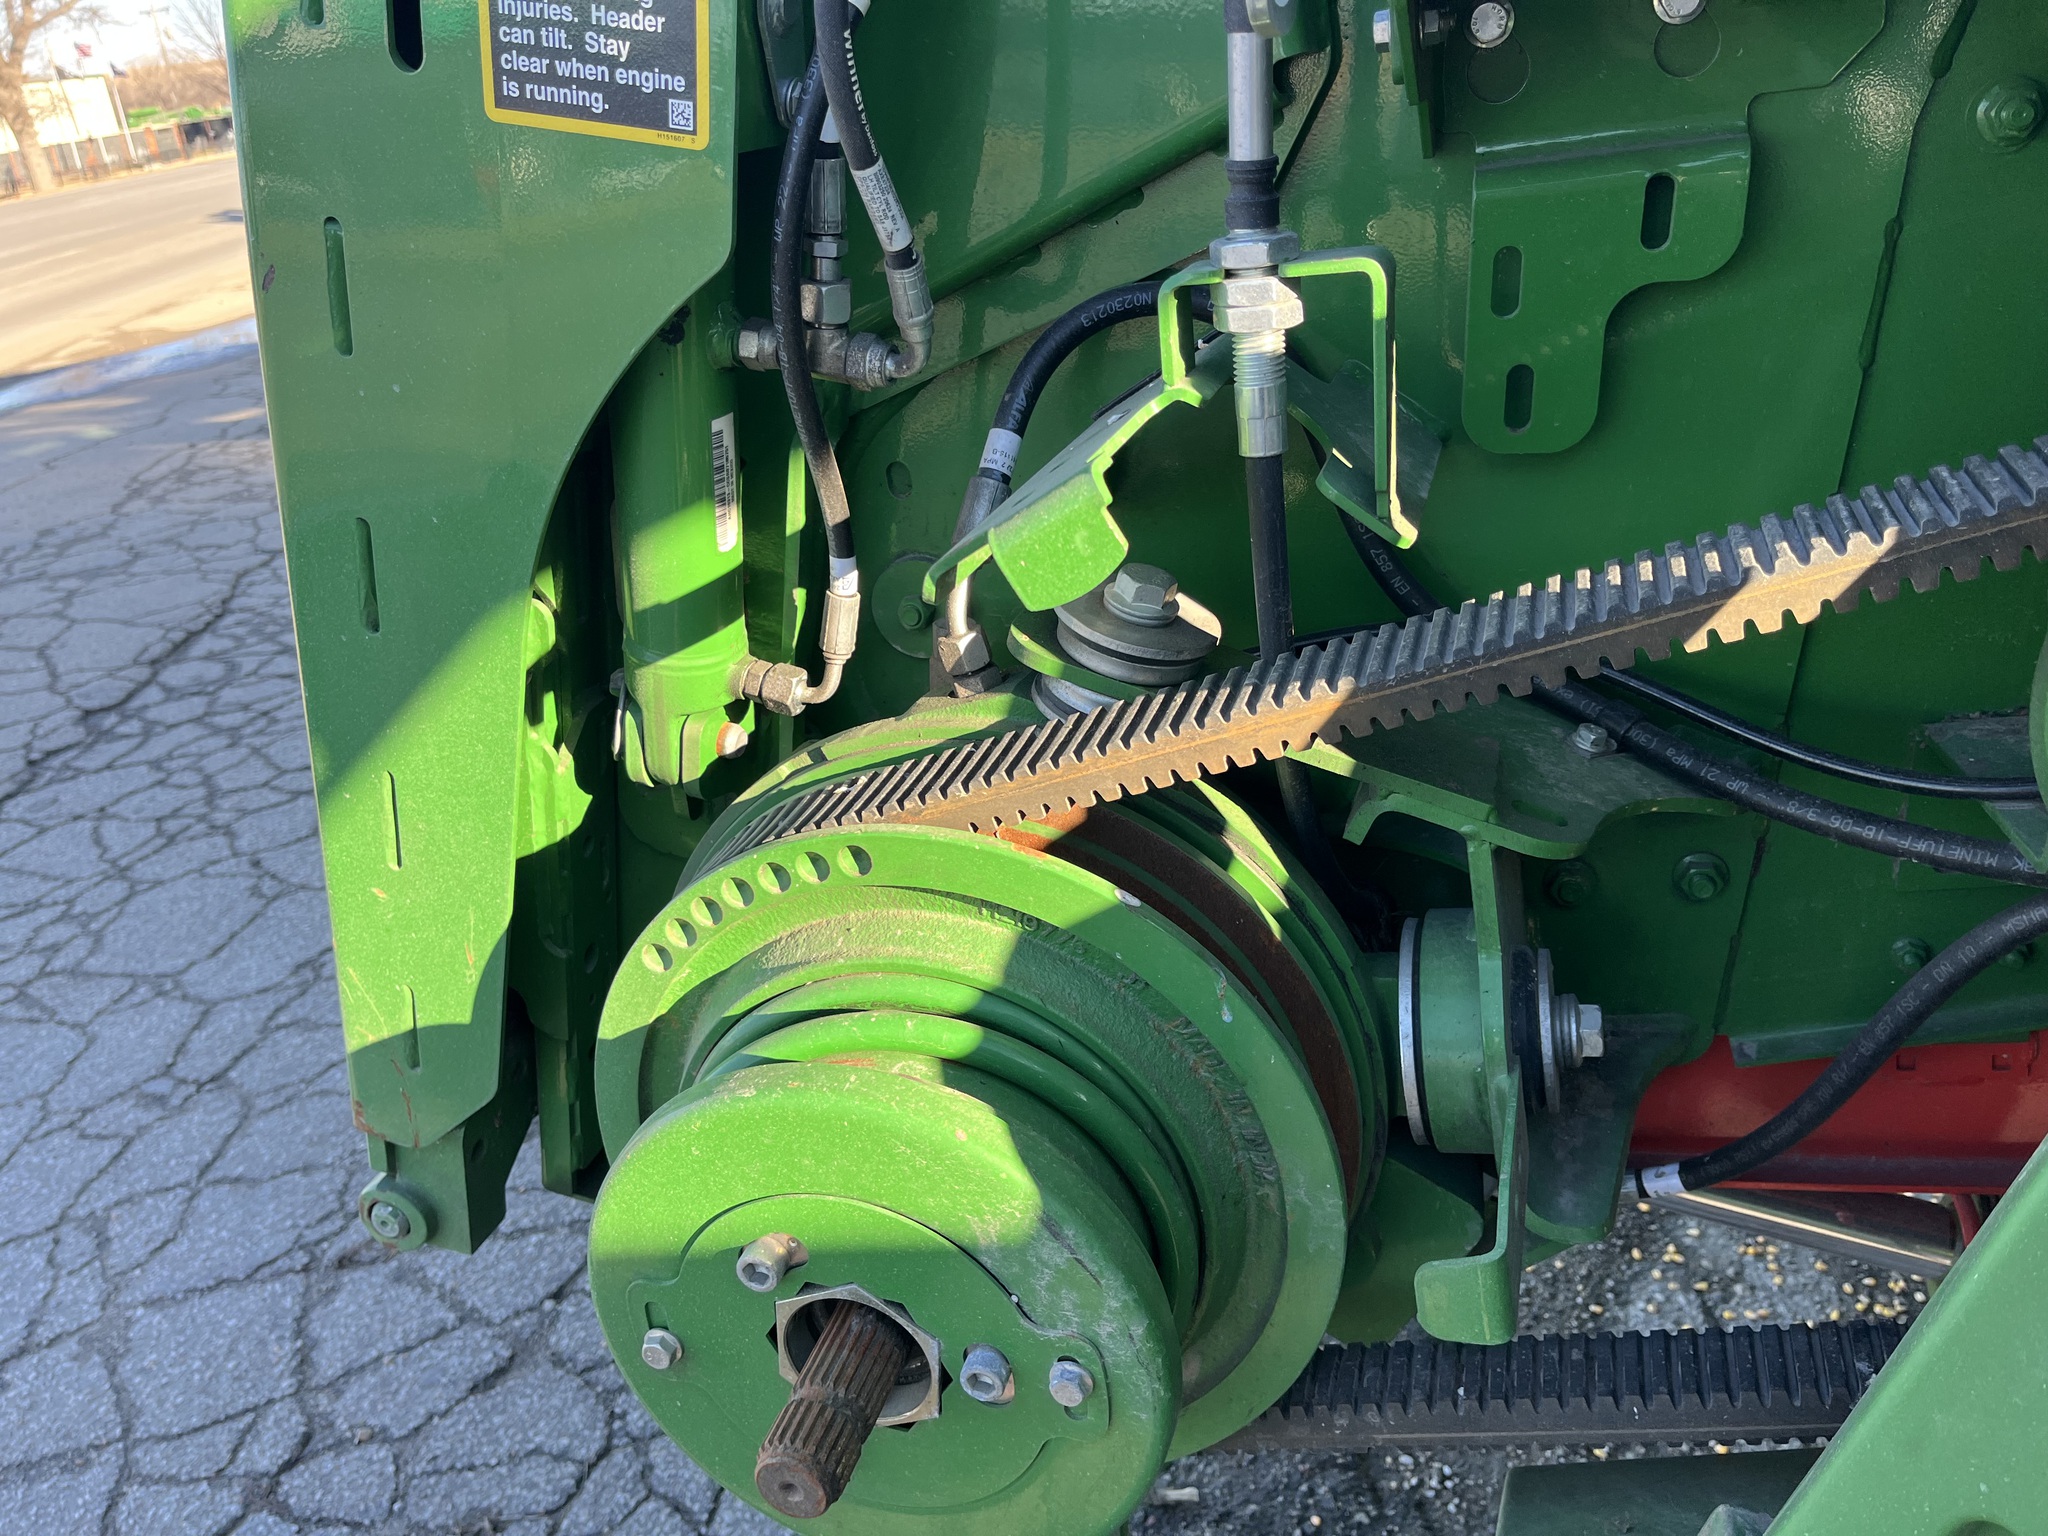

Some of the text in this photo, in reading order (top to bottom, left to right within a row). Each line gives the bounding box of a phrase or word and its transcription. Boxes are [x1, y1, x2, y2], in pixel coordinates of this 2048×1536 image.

[591, 4, 666, 33] Header
[499, 26, 631, 61] can tilt. Stay
[500, 50, 686, 93] clear when engine
[801, 54, 820, 99] (330
[502, 76, 610, 113] is running.
[1369, 547, 1394, 573] 857
[1390, 575, 1411, 595] EN
[1665, 747, 1694, 769] MPa
[1699, 761, 1718, 780] 21
